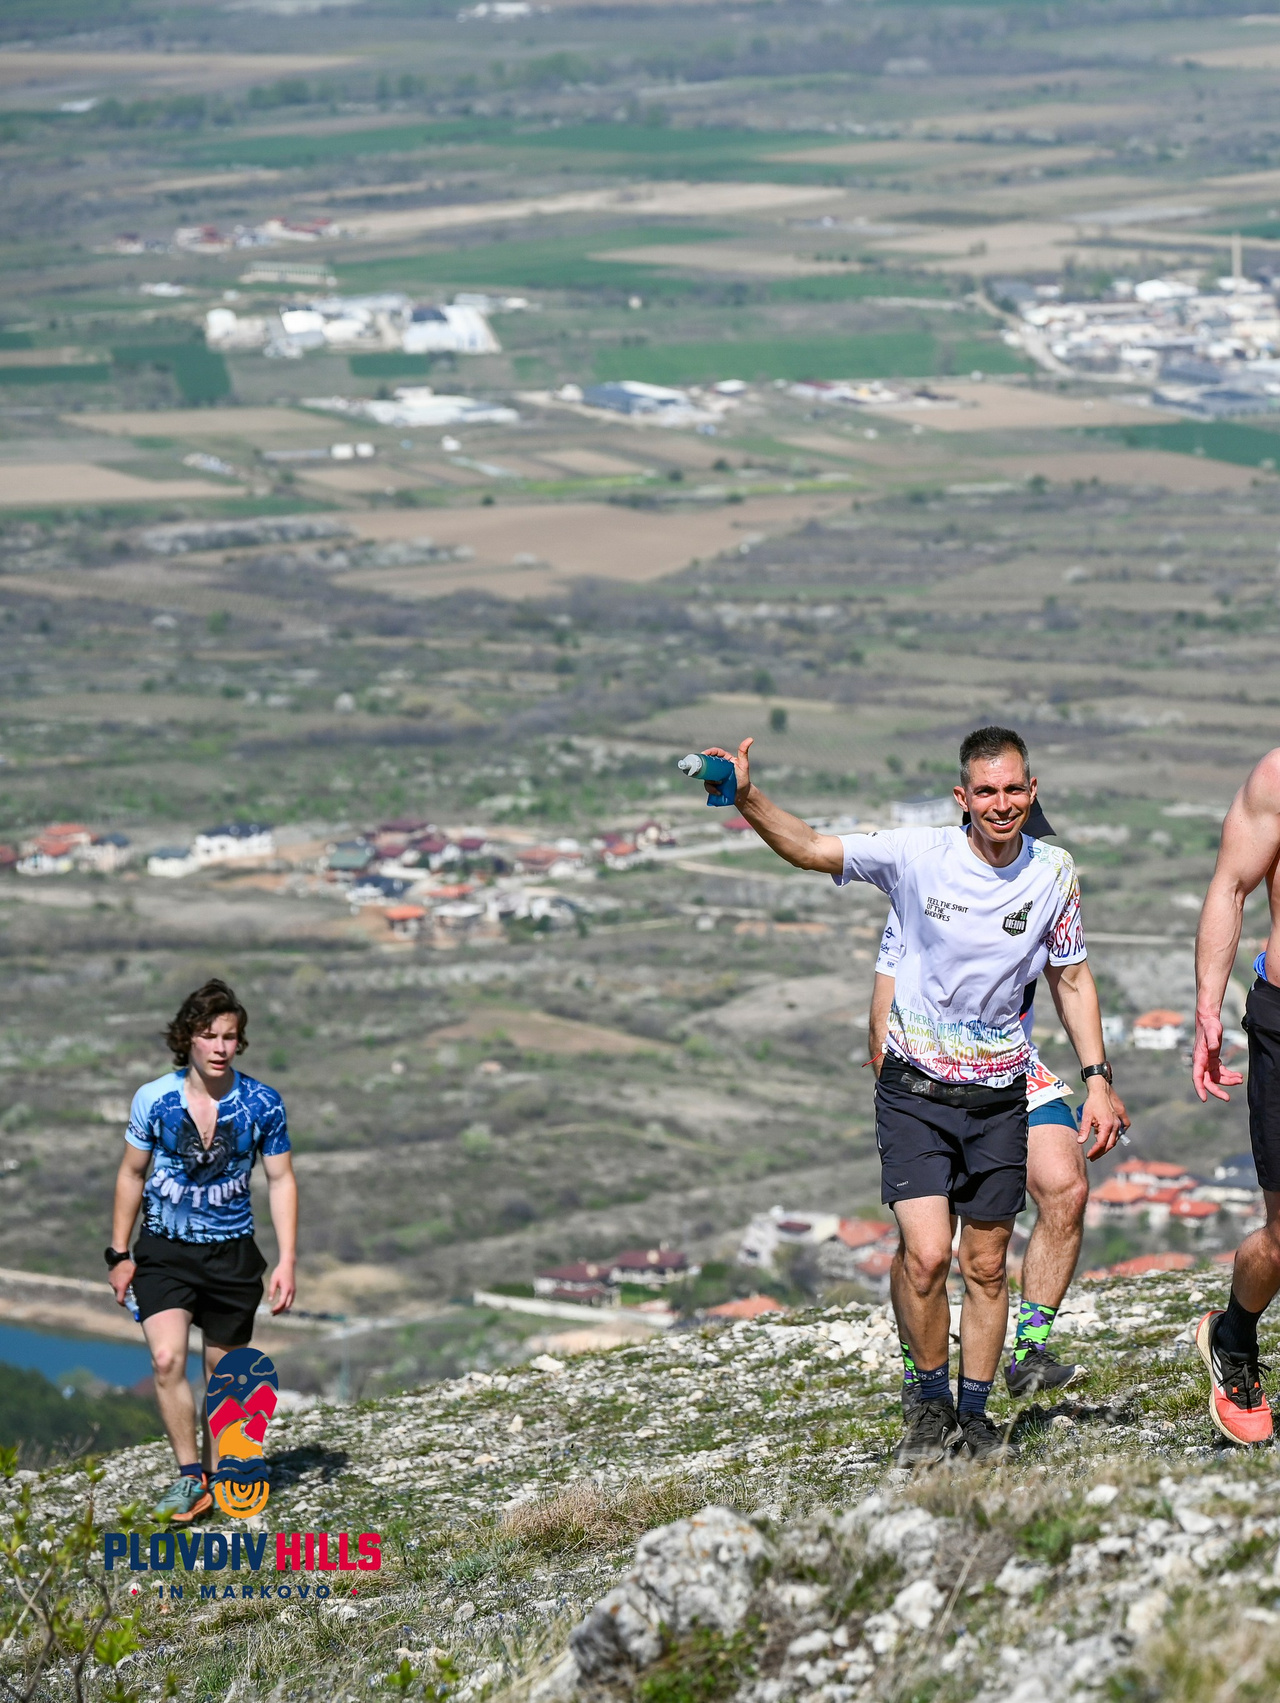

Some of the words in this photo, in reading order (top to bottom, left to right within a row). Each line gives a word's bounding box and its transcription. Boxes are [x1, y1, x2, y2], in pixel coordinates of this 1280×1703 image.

[927, 896, 939, 906] FEEL
[940, 900, 951, 909] THE
[934, 905, 945, 914] THE
